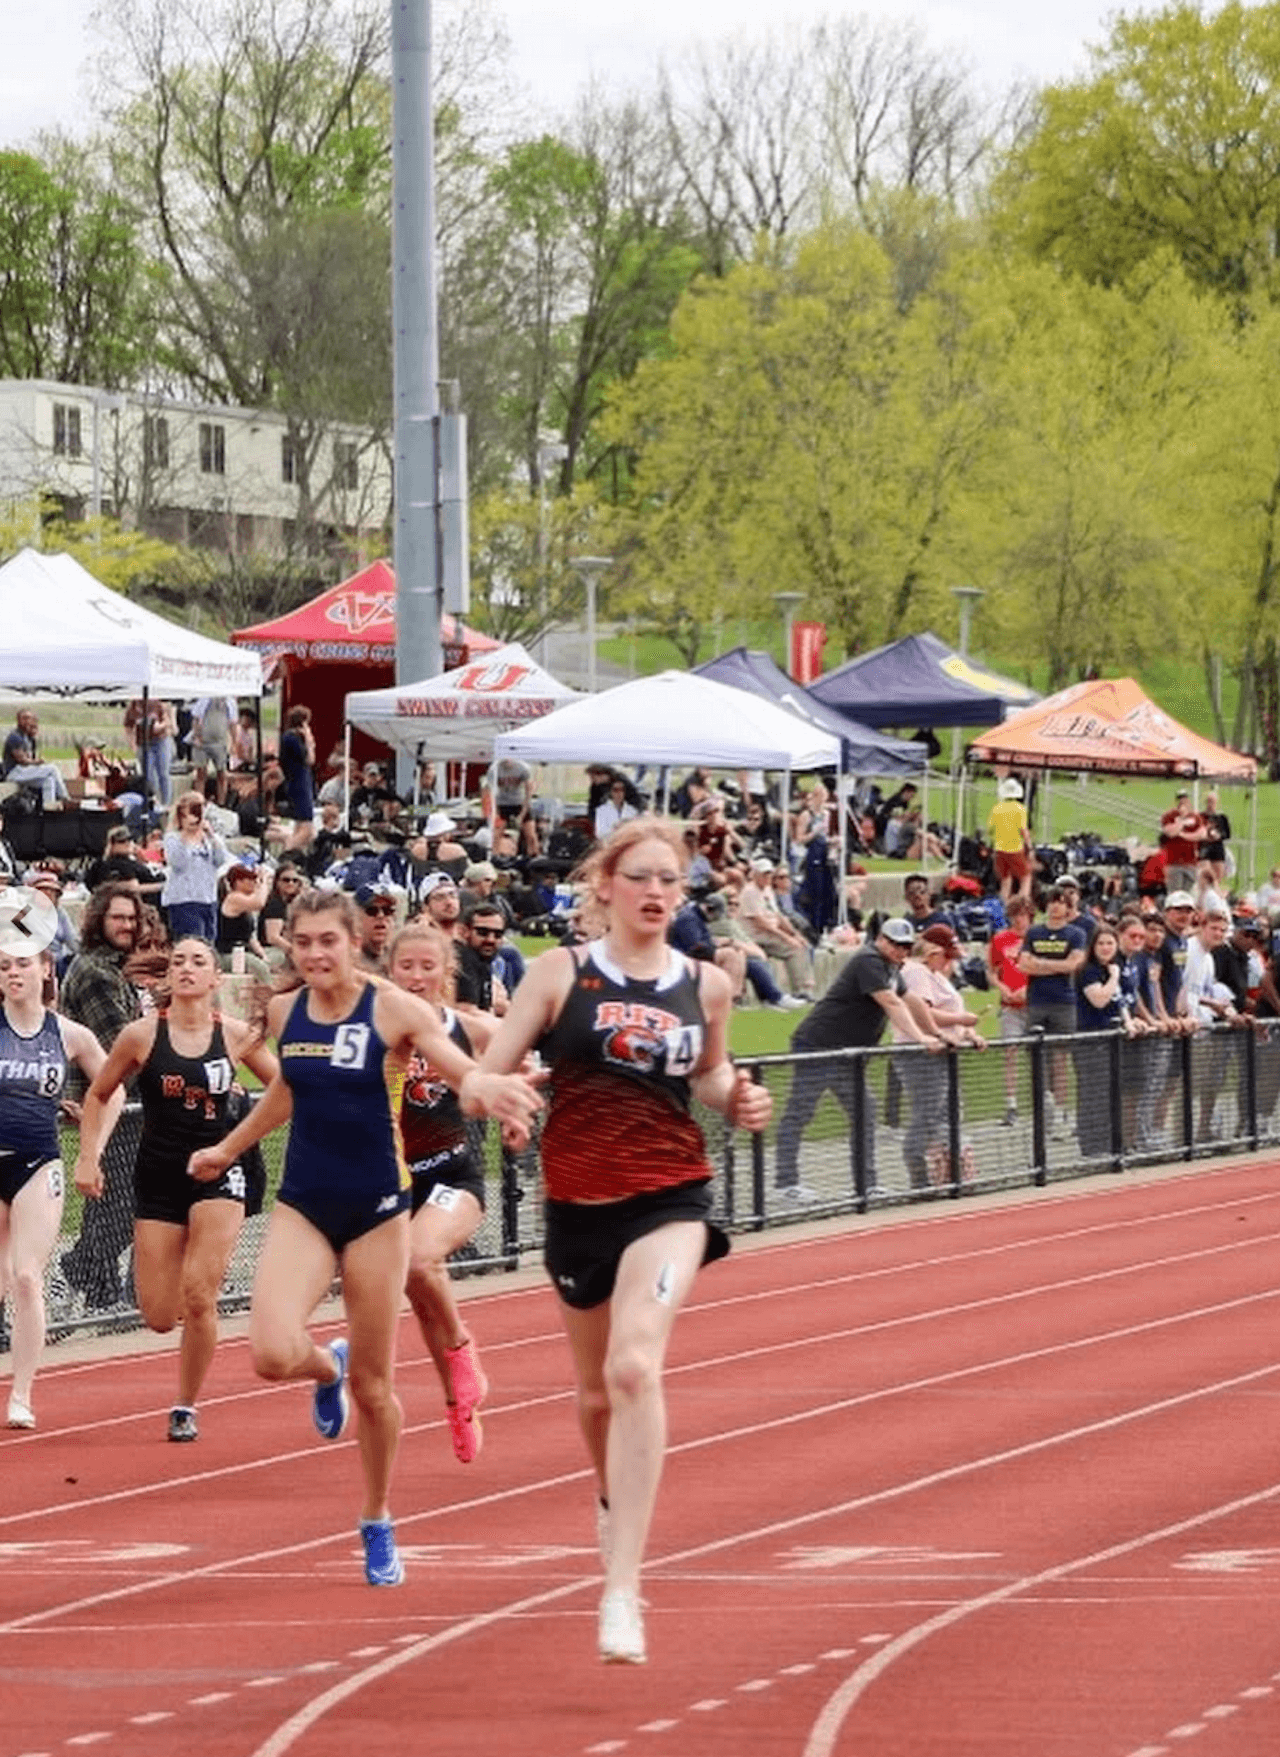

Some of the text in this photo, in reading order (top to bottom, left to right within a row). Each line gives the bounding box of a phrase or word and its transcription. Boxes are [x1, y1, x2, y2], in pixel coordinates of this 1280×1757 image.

[593, 1001, 682, 1035] RIT
[340, 1028, 362, 1064] 5
[674, 1030, 695, 1069] 4
[0, 1060, 44, 1080] THA
[44, 1067, 58, 1094] 8
[211, 1063, 223, 1092] 7
[435, 1189, 455, 1205] 6
